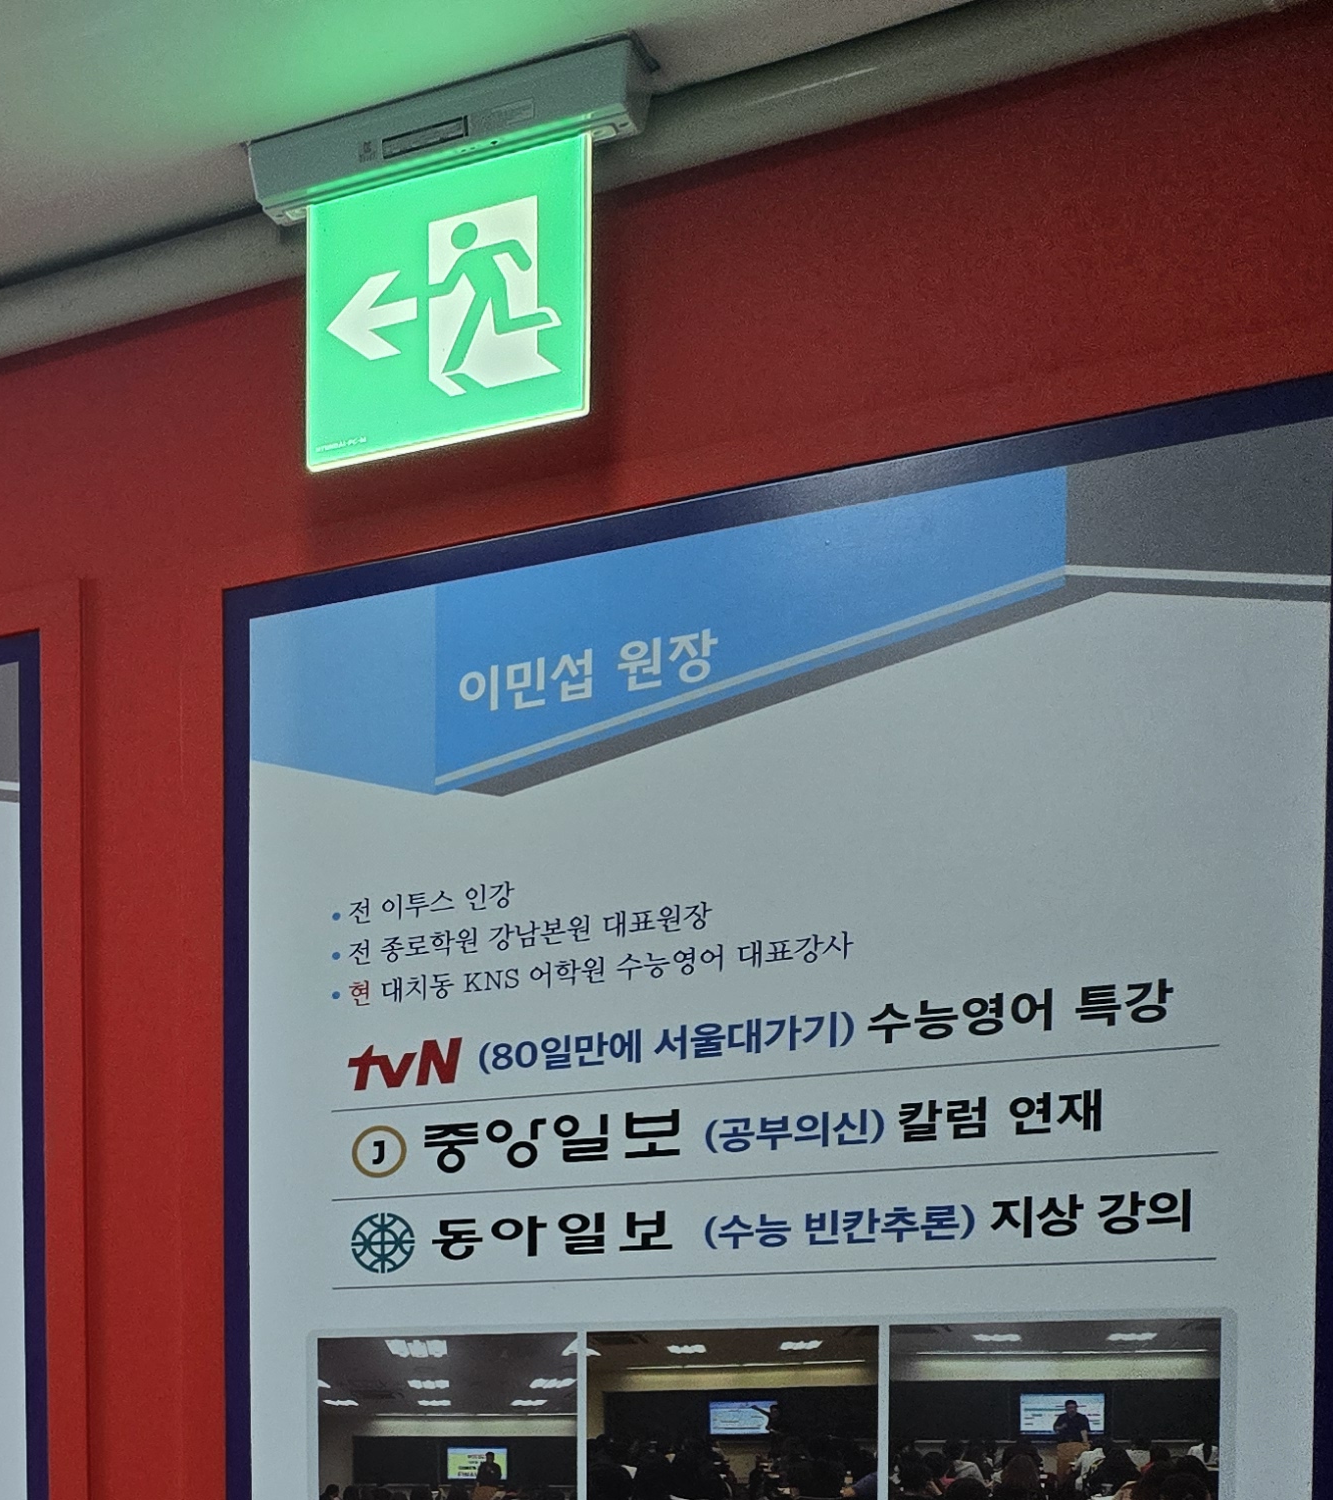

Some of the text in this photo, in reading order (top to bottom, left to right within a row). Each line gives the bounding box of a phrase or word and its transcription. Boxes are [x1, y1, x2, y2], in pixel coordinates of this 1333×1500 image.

[459, 628, 718, 712] 이민섭 원장
[348, 881, 515, 924] 전 이투스 인강
[348, 901, 713, 966] 전 종로학원 강남본원 대표원장
[348, 930, 854, 1007] 현 대치동 KNS 어학원 수능영어 대표강사
[347, 978, 1174, 1091] tvN (80일만에 서울대가기) 수능영어 특강
[424, 1108, 681, 1174] 중앙일보
[705, 1108, 885, 1154] (공부의신)
[898, 1096, 988, 1143] 칼럼
[1009, 1088, 1102, 1135] 연재
[432, 1189, 1192, 1261] 동아일보 (수능 빈칸추론) 지상 강의
